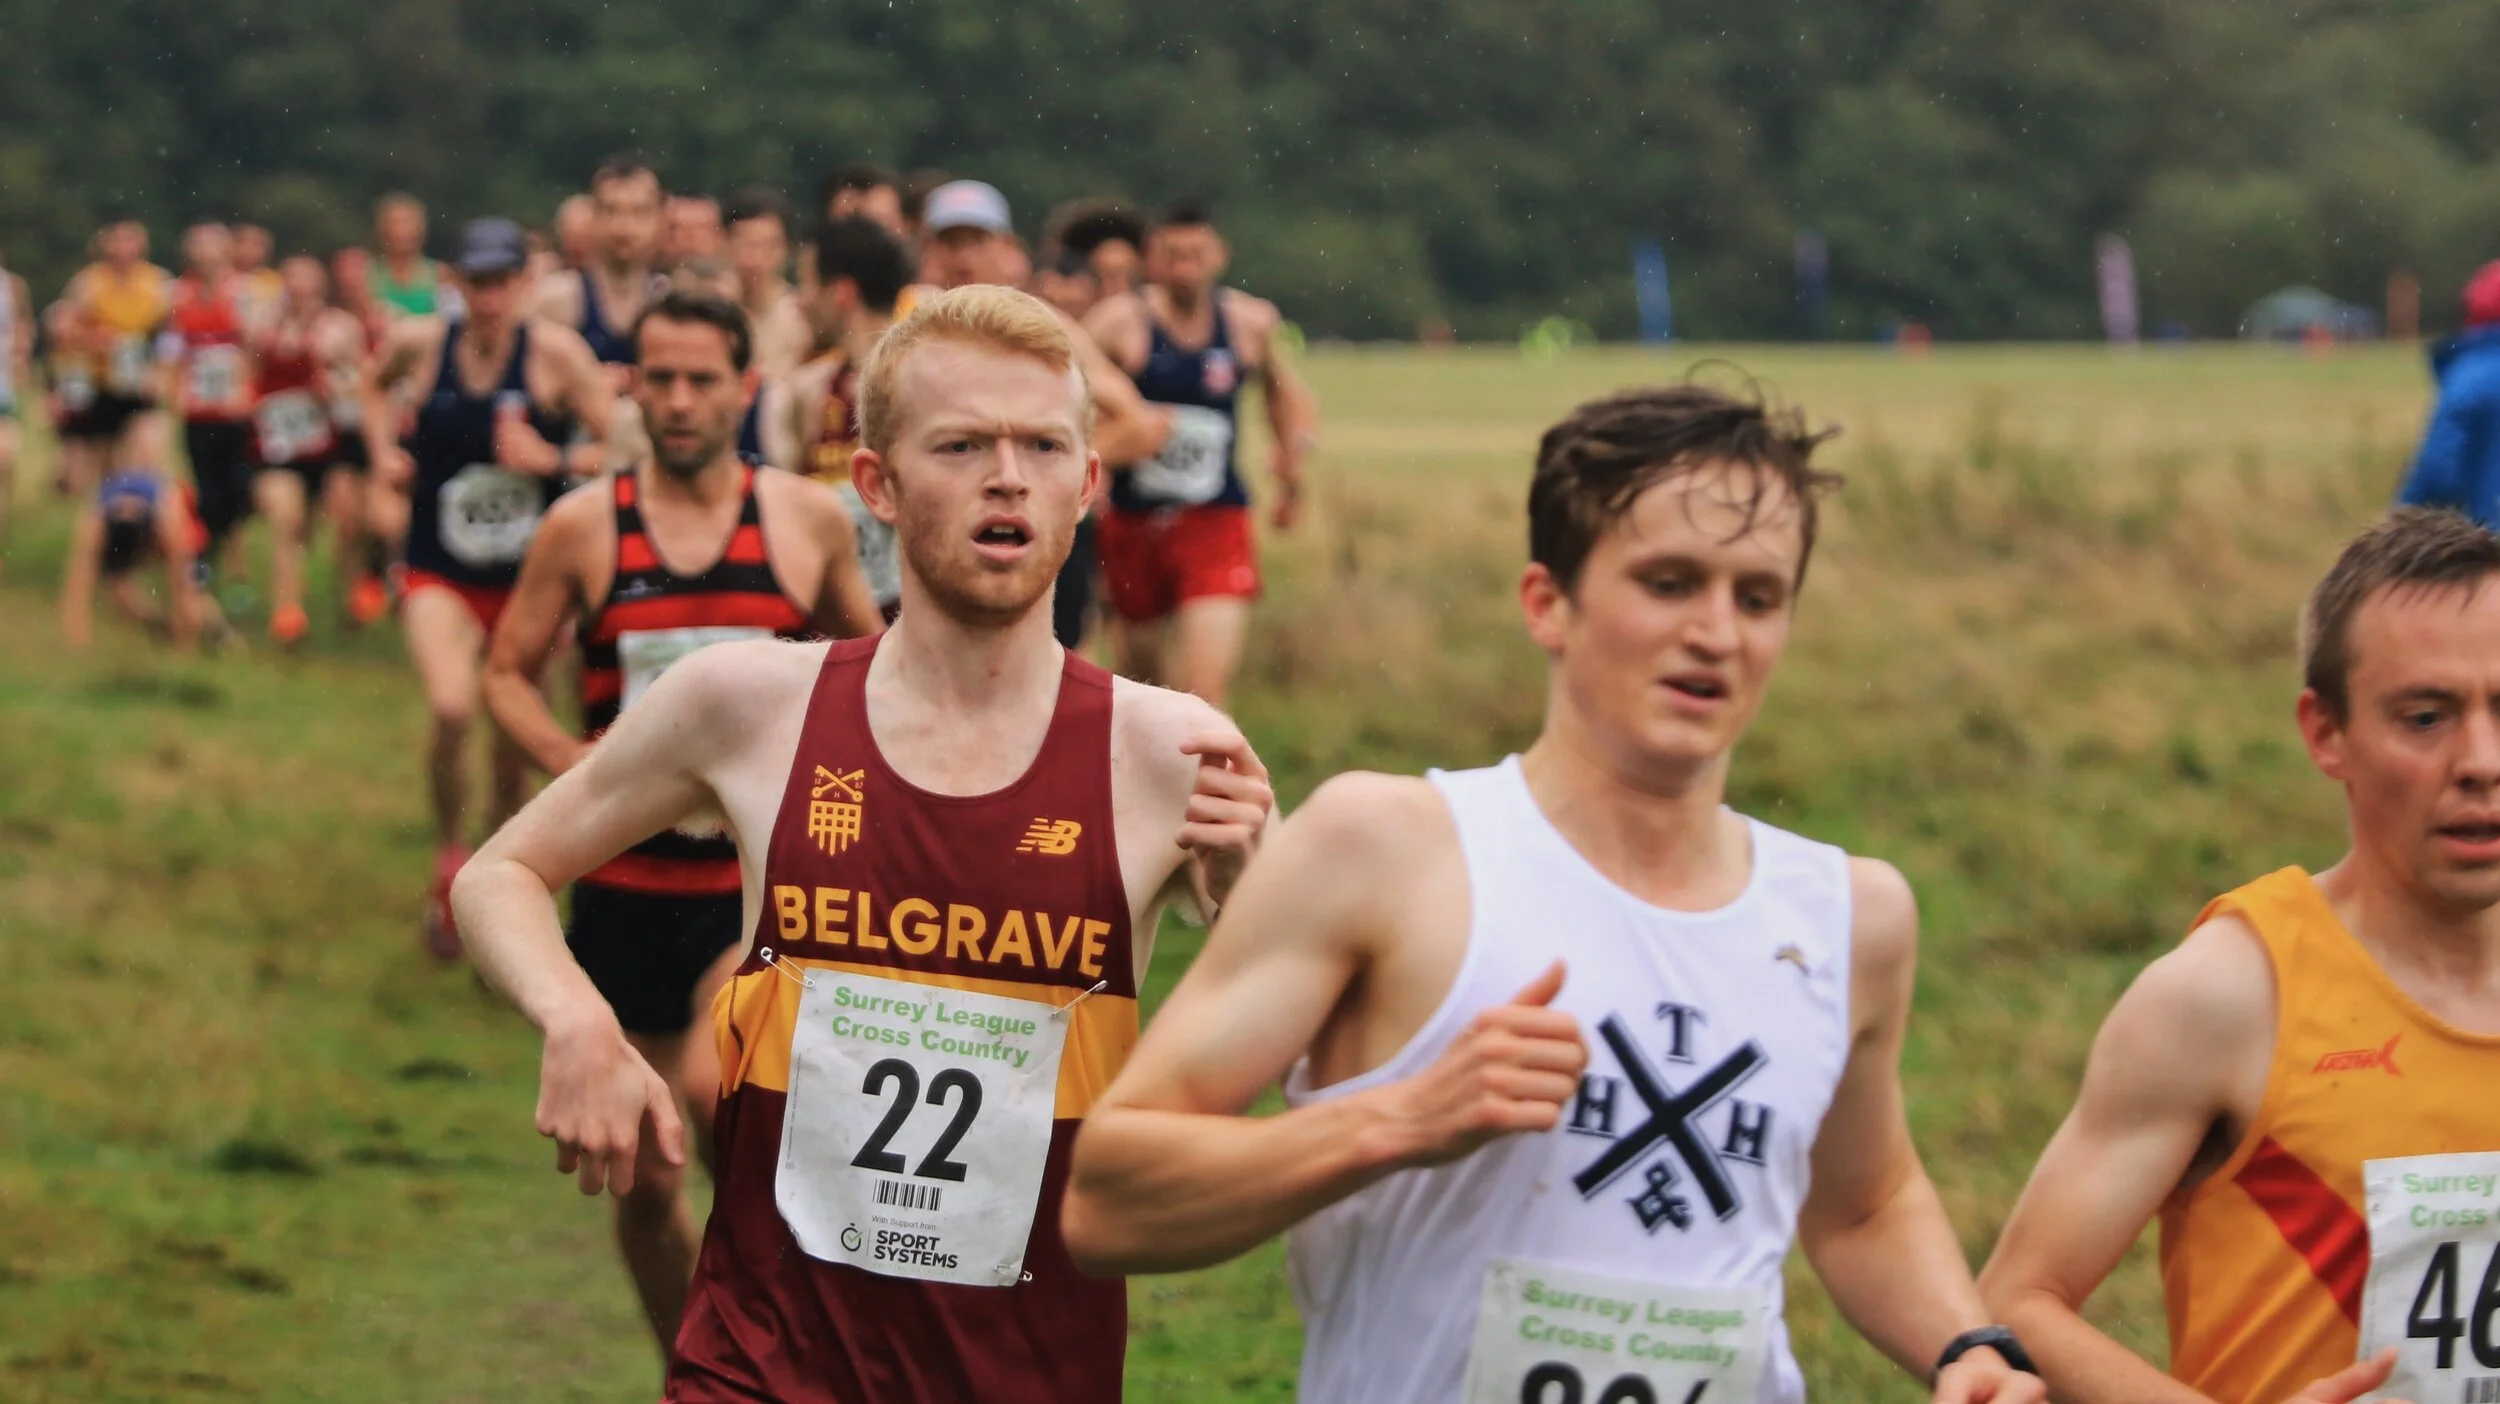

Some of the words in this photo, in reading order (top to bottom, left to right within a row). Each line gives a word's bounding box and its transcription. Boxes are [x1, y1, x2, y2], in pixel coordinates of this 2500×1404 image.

[774, 885, 1111, 977] BELGRAVE
[834, 986, 927, 1023] Surrey
[935, 1001, 1037, 1036] League
[1655, 1001, 1708, 1065] T
[831, 1015, 912, 1046] Cross
[920, 1029, 1030, 1068] Country
[850, 1058, 983, 1183] 22
[1567, 1071, 1624, 1140] H
[1720, 1097, 1776, 1167] H
[2402, 1172, 2497, 1198] Surrey
[876, 1230, 941, 1251] SPORT
[890, 1217, 919, 1229] Support
[919, 1221, 937, 1231] from
[2410, 1204, 2488, 1228] Cross
[873, 1245, 958, 1269] SYSTEMS
[1523, 1279, 1636, 1325] Surrey
[1646, 1299, 1746, 1334] League
[1519, 1314, 1616, 1352] Cross
[1627, 1332, 1738, 1368] Country
